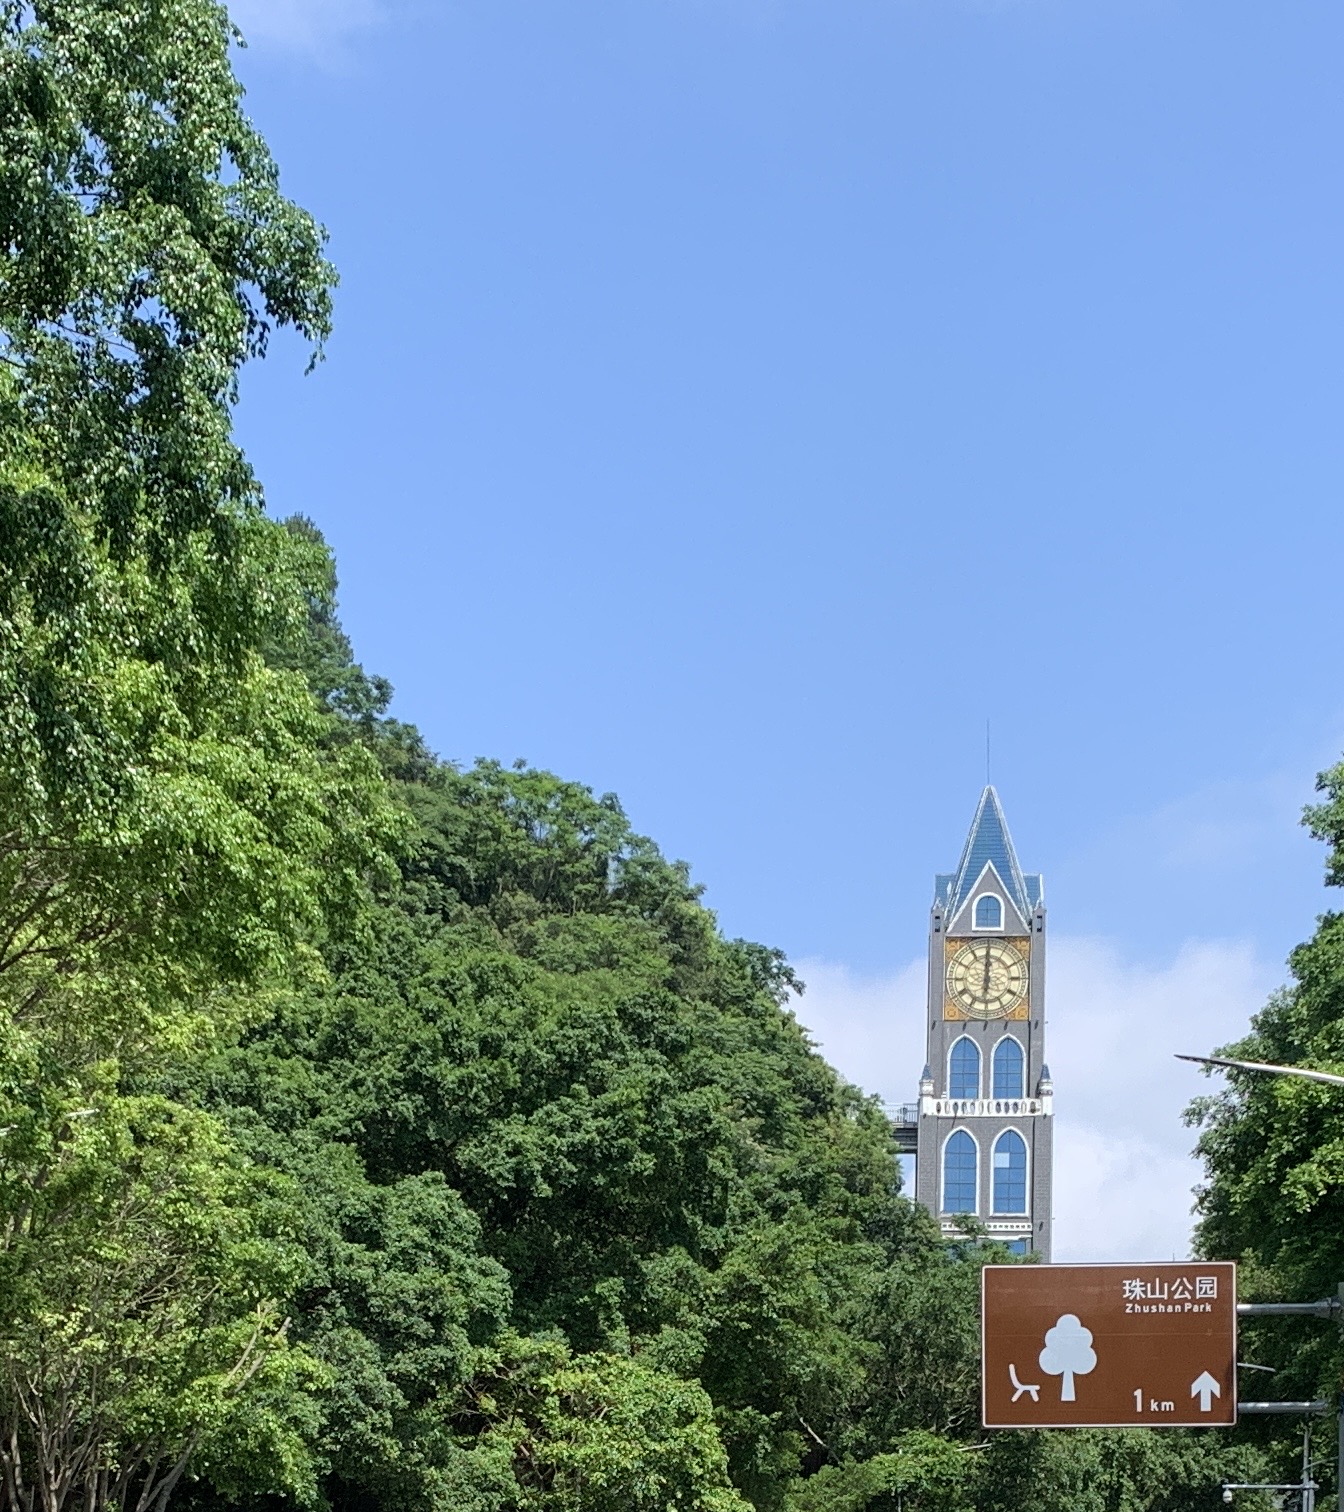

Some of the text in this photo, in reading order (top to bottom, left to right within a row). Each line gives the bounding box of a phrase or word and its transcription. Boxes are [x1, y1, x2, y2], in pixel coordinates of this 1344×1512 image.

[1122, 1276, 1218, 1300] 珠山公园
[1125, 1302, 1212, 1314] Zhushan Park
[1133, 1388, 1175, 1413] 1 km
